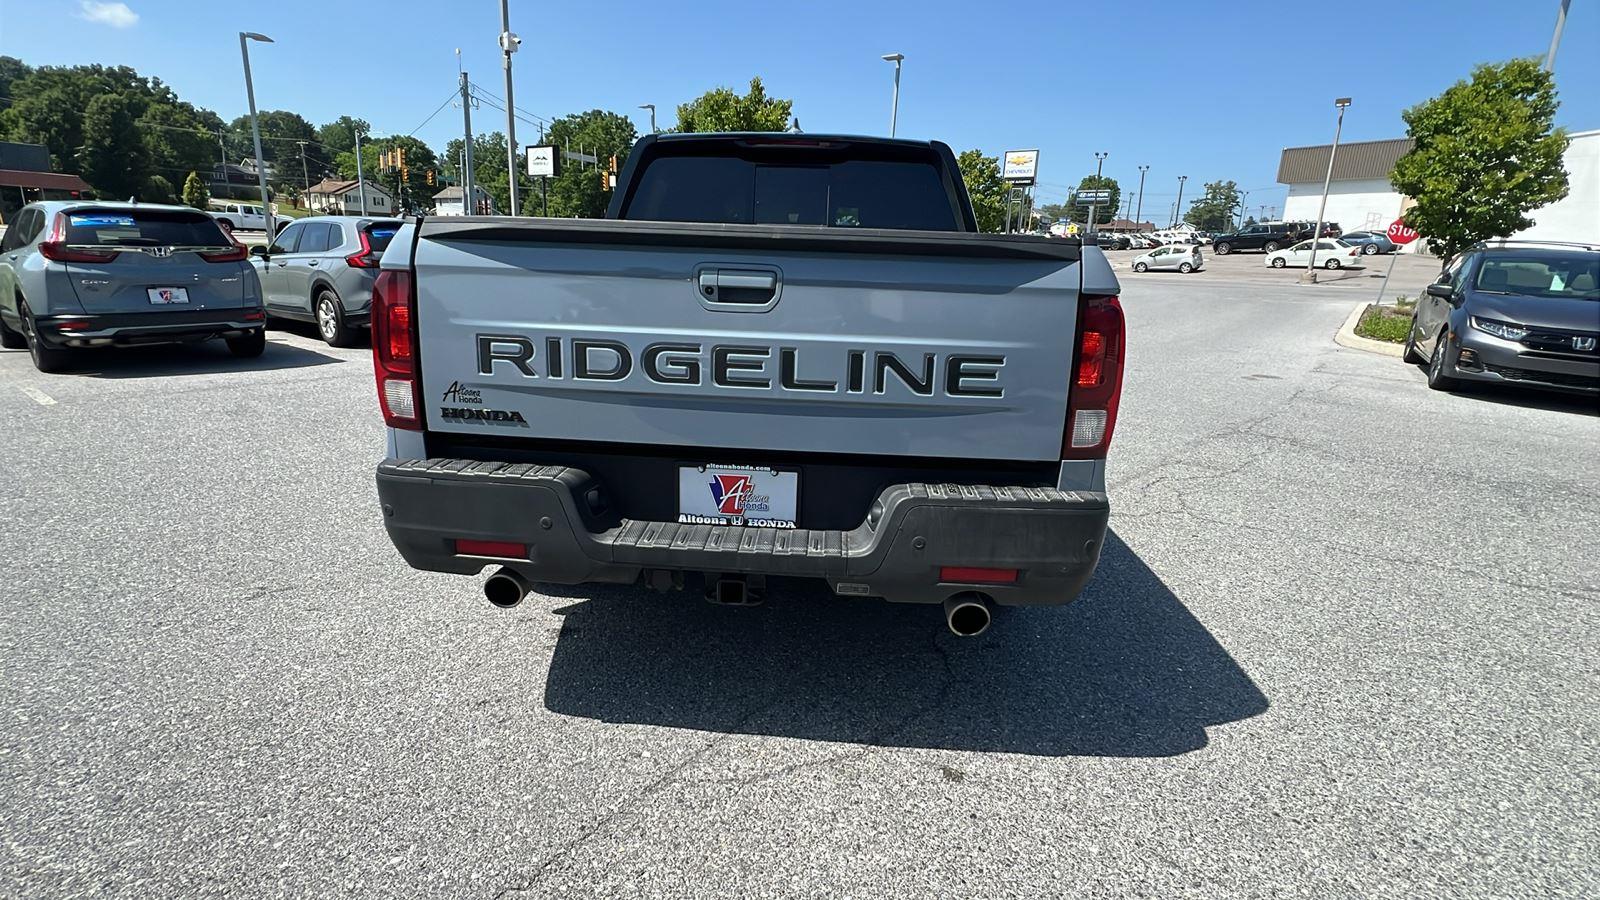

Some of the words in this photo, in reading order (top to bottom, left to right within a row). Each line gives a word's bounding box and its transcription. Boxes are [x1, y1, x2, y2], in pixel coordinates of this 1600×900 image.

[476, 333, 1005, 398] RIDGELINE
[443, 380, 481, 403] Altoona
[459, 396, 482, 404] Honda
[440, 407, 527, 423] HONDA
[706, 463, 771, 472] altoonahonda.com
[719, 479, 769, 510] Altoona
[739, 500, 769, 511] Honda
[678, 514, 728, 526] Altoona
[747, 518, 797, 529] HONDA
